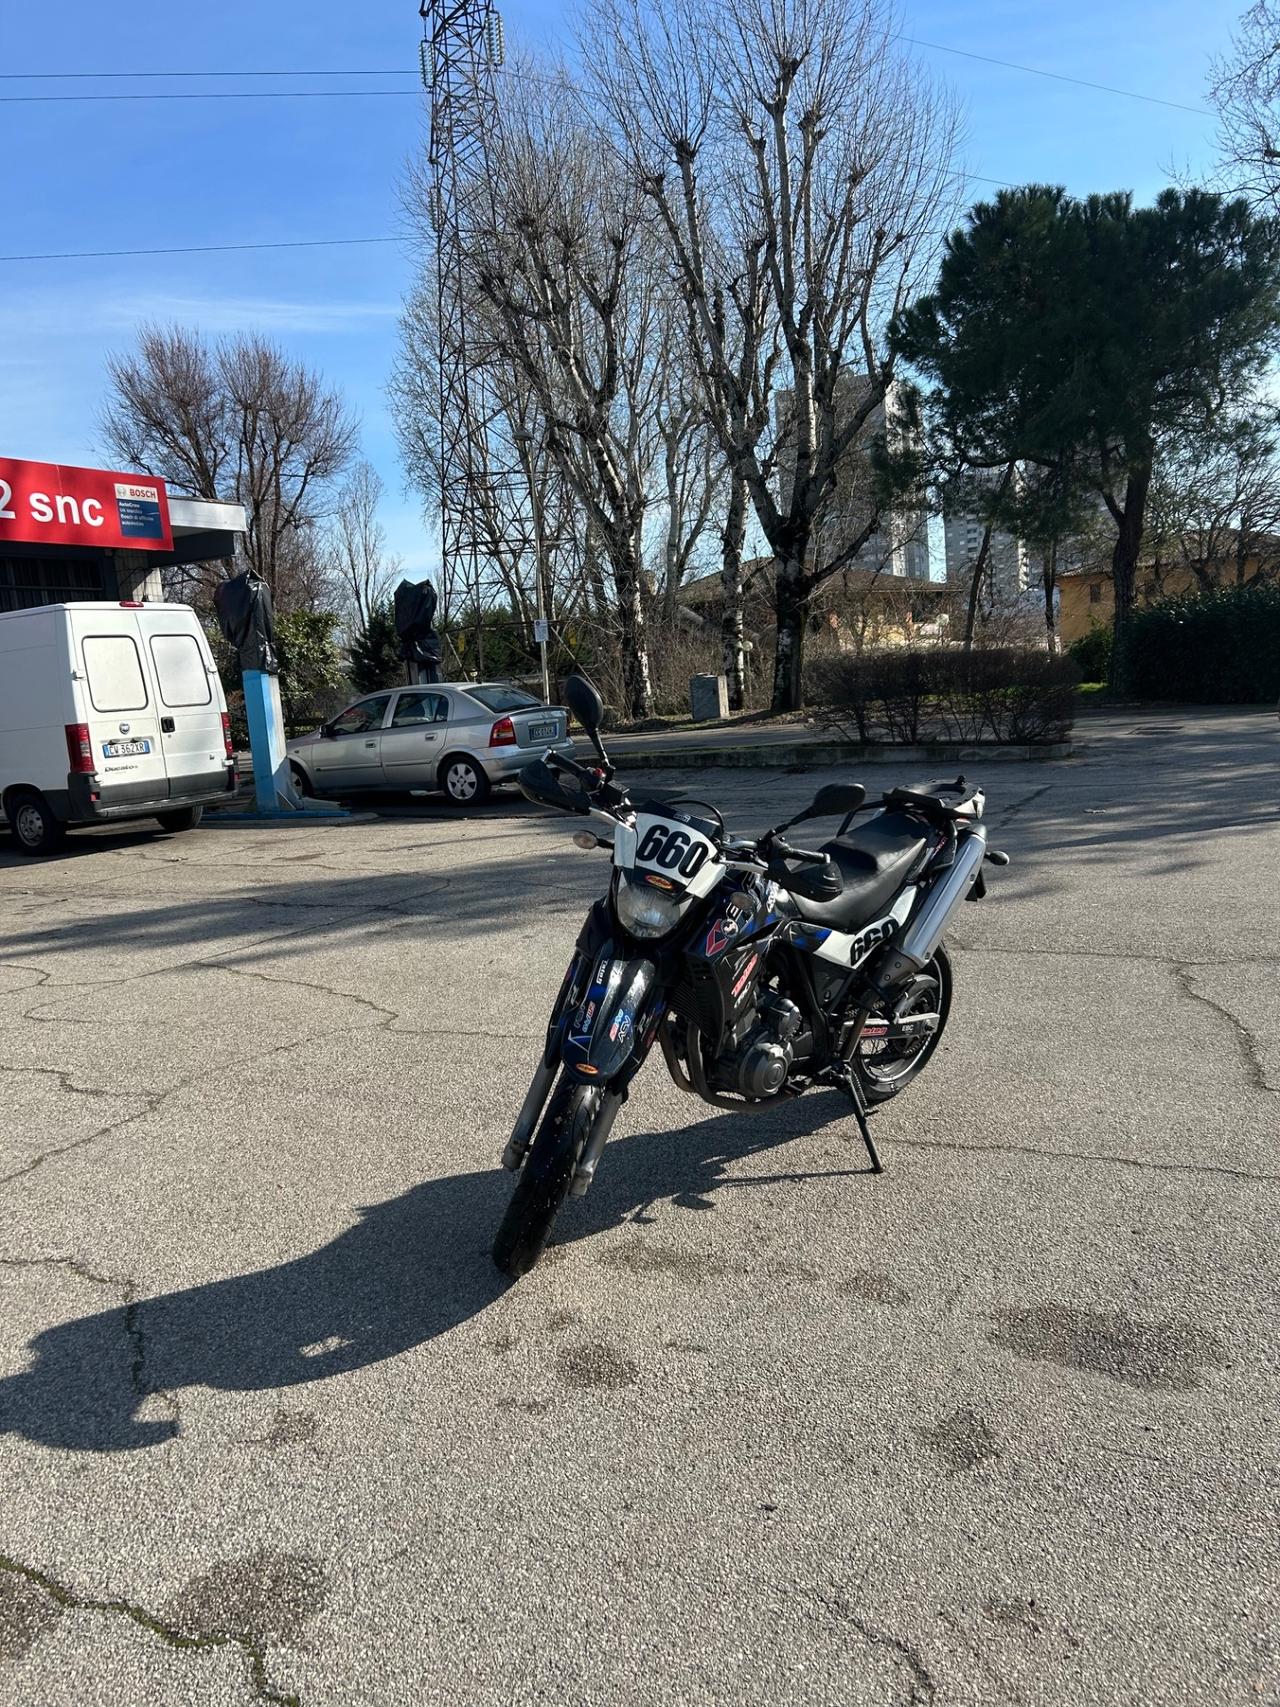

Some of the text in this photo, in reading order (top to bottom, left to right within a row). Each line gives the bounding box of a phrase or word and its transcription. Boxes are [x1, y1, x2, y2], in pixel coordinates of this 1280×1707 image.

[29, 492, 105, 527] snc
[129, 488, 156, 498] BOSCH
[636, 824, 709, 879] 660
[850, 918, 899, 966] 660
